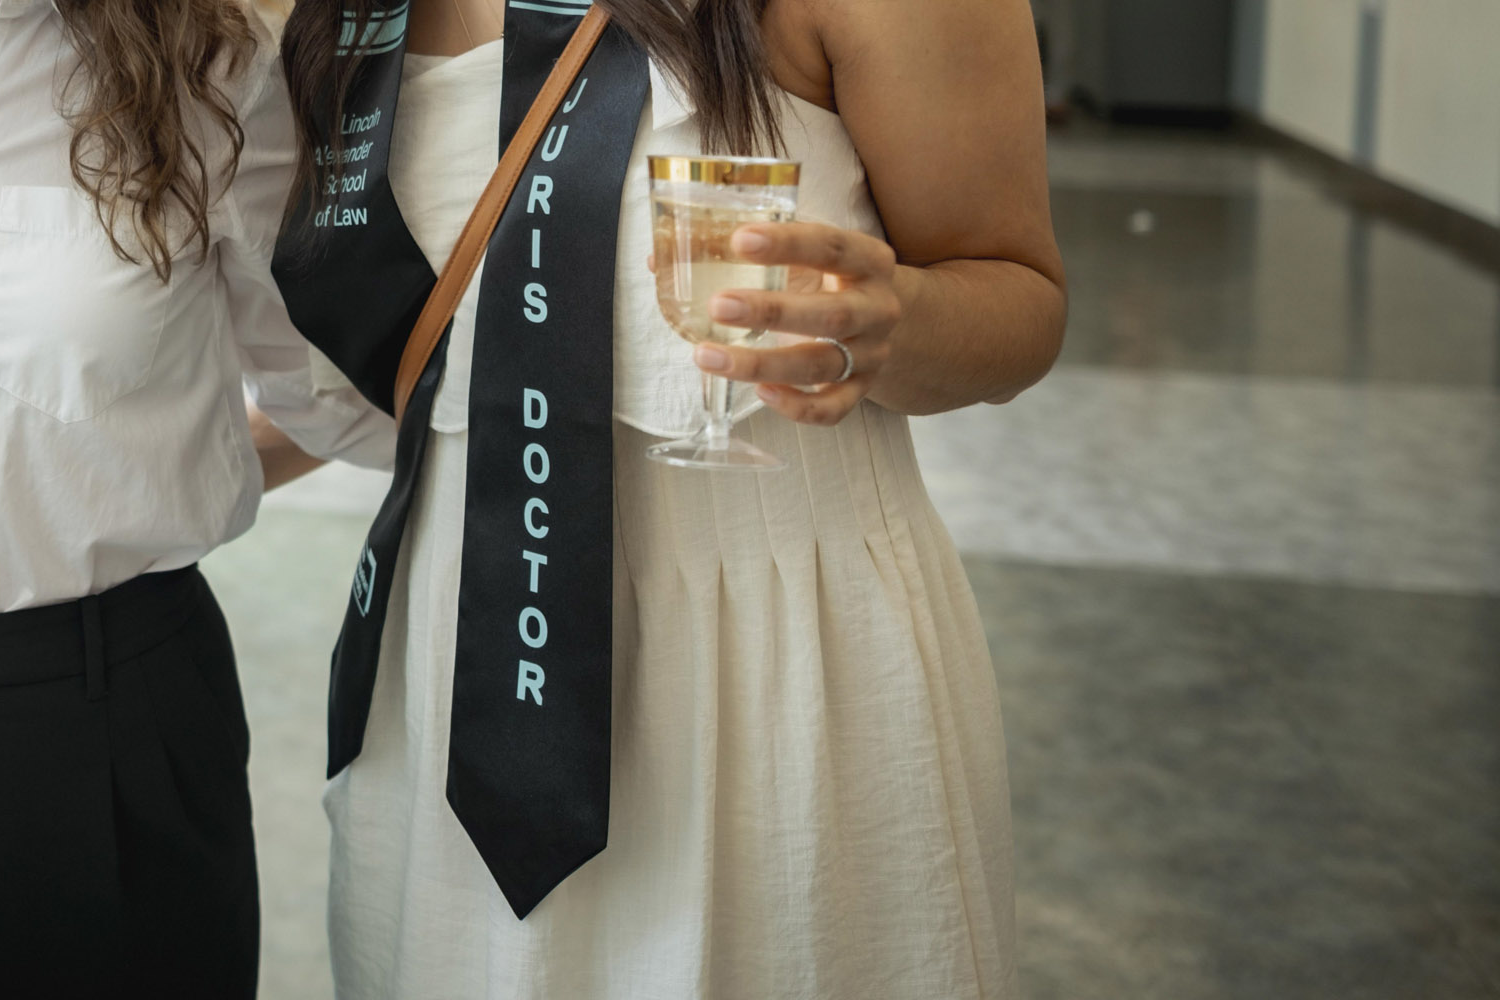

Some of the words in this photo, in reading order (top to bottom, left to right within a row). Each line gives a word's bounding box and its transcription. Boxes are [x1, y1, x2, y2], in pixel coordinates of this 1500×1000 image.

[341, 107, 381, 135] Lincoln
[324, 169, 367, 195] School
[523, 77, 588, 324] JURIS
[314, 204, 332, 228] of
[334, 204, 367, 226] Law
[516, 387, 550, 706] DOCTOR
